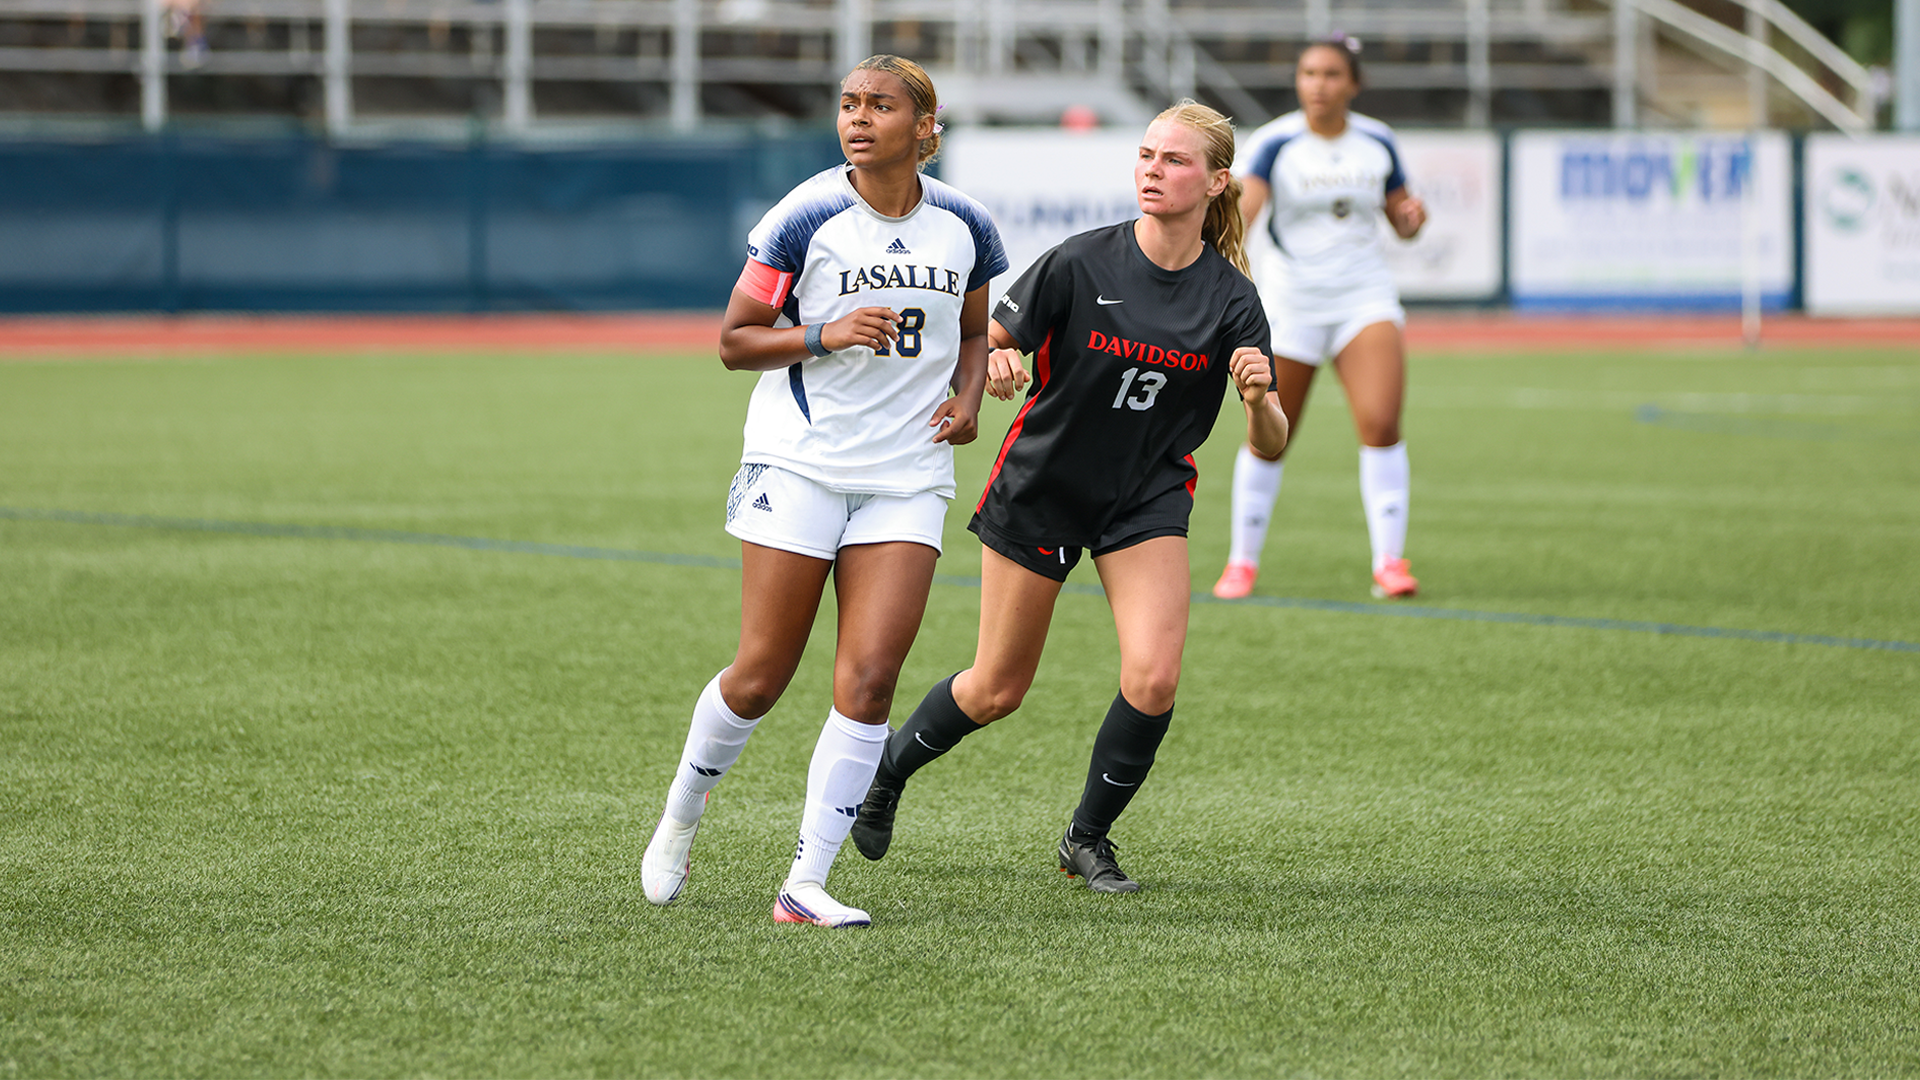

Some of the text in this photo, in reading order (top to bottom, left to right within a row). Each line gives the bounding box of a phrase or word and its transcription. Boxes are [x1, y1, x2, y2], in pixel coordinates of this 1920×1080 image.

[838, 264, 960, 298] LASALLE
[1087, 330, 1210, 371] DAVIDSON
[1112, 367, 1168, 411] 13
